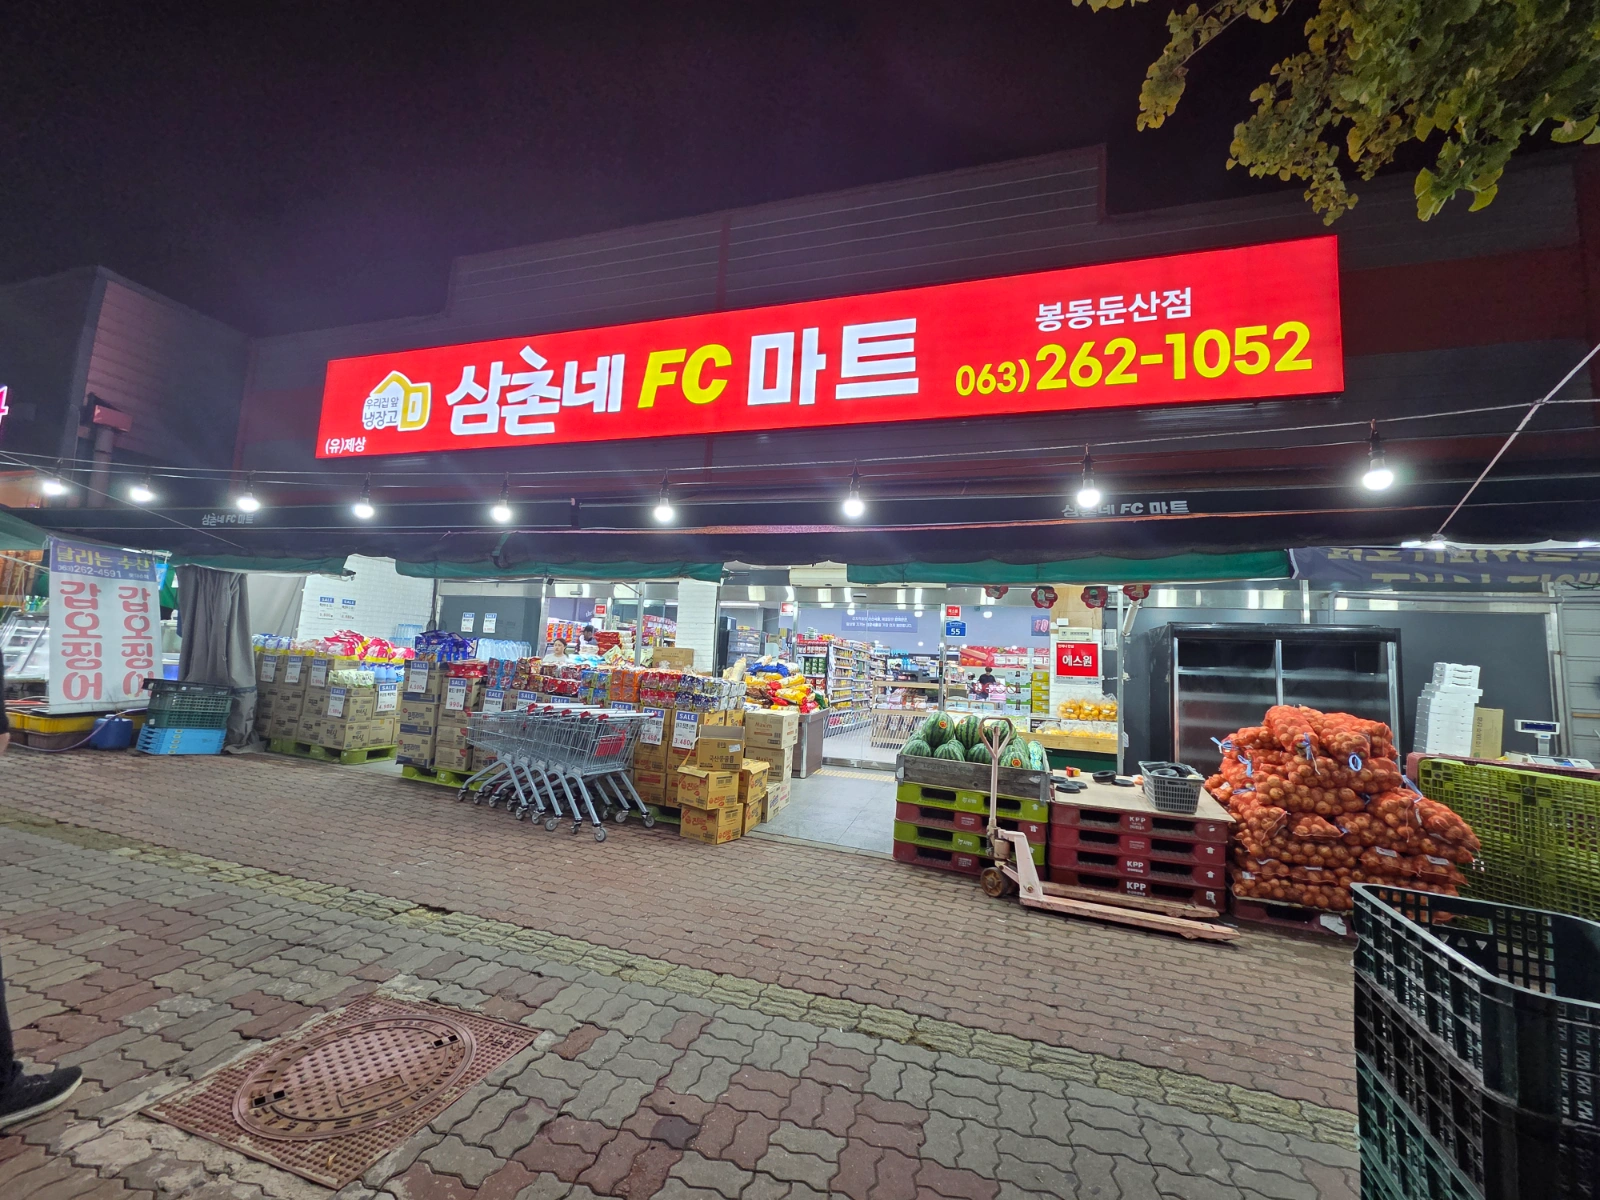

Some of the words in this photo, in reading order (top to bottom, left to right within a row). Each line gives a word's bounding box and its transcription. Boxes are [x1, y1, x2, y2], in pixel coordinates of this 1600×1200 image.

[1036, 287, 1192, 332] 봉동둔산점
[446, 344, 626, 436] 삼촌네
[638, 343, 732, 408] FC
[747, 318, 919, 406] 마트
[366, 398, 389, 409] 우리집
[390, 396, 400, 408] 앞
[364, 410, 398, 427] 냉장고
[325, 436, 366, 454] (유)제상
[1120, 502, 1144, 514] FC
[1148, 500, 1190, 514] 마트
[202, 512, 225, 526] 삼촌네
[226, 514, 237, 524] FC
[238, 514, 254, 524] 마트
[56, 546, 113, 568] 달리는
[118, 555, 152, 572] 수산
[60, 580, 103, 700] 갑오징어
[1062, 654, 1092, 667] 에스원
[1126, 881, 1146, 891] KPP
